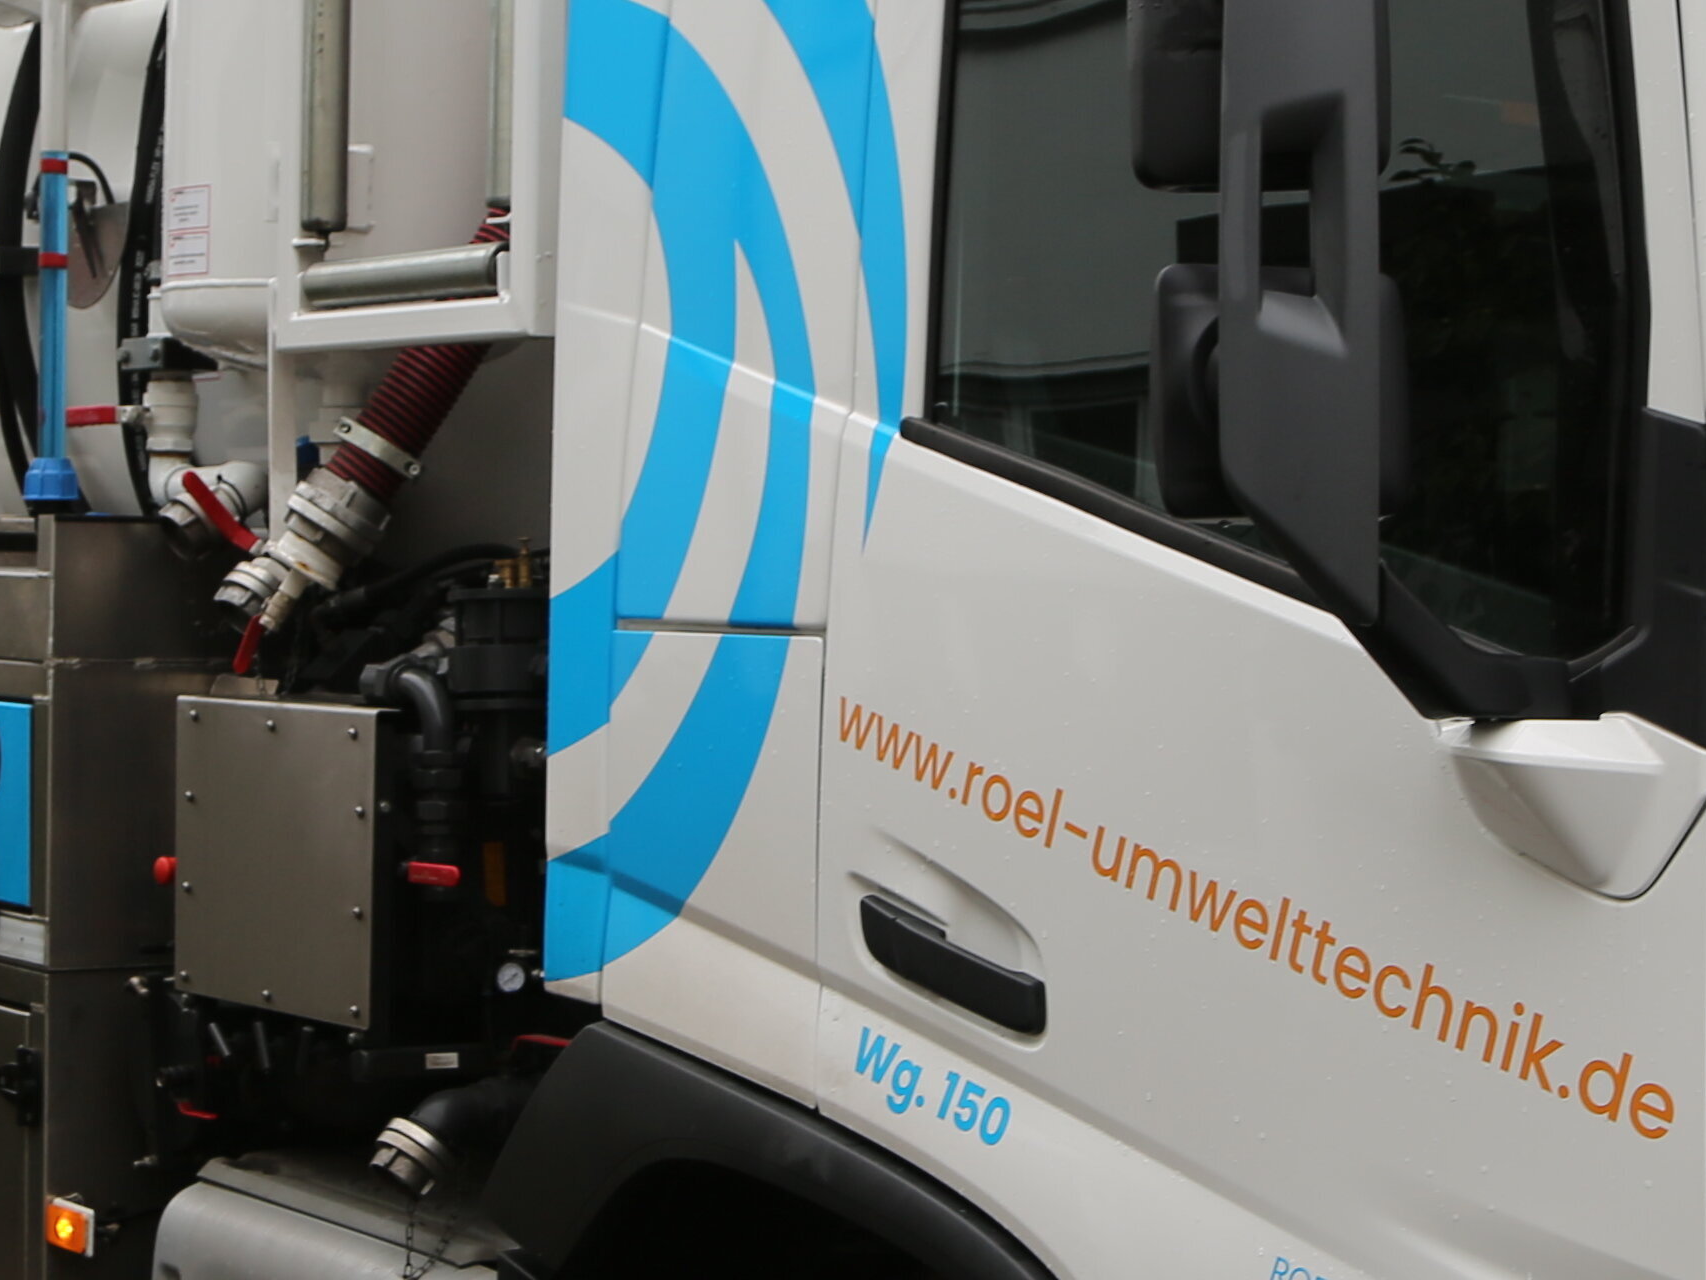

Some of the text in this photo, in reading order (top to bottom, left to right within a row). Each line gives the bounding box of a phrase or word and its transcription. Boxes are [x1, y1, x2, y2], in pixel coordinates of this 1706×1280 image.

[837, 694, 1676, 1140] www.roel-umwelttechnik.de
[853, 1024, 1012, 1147] Wg. 150
